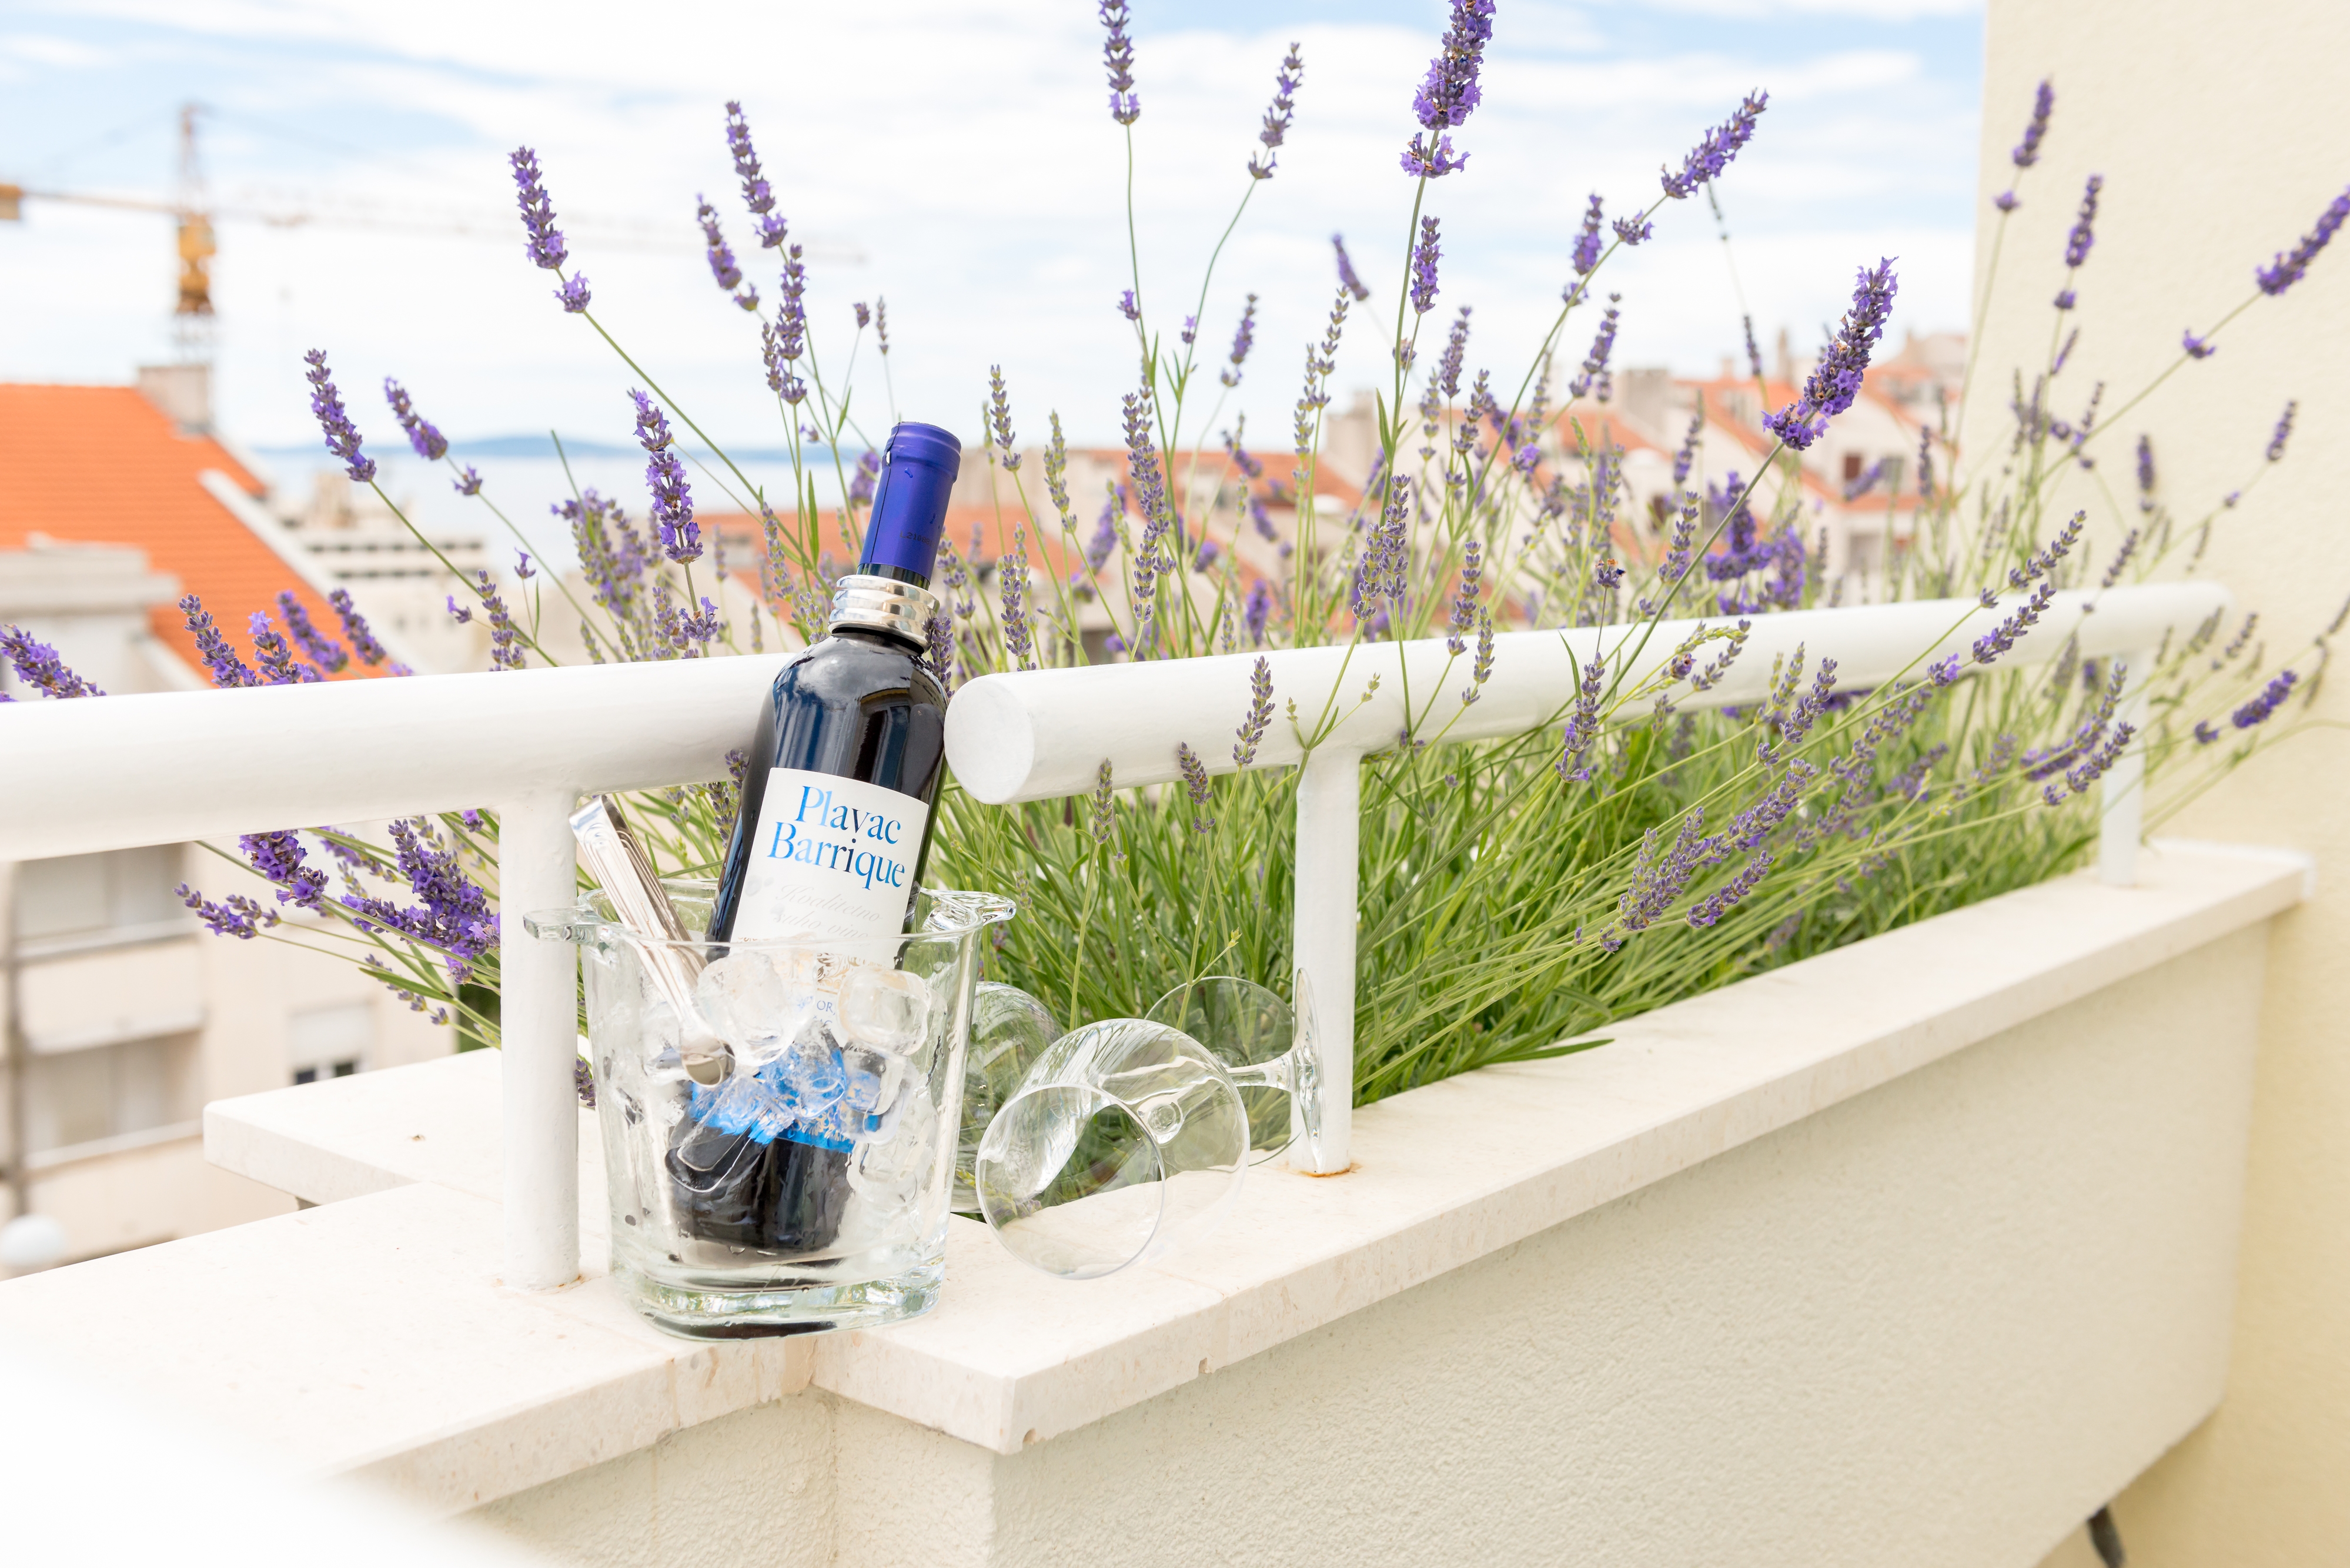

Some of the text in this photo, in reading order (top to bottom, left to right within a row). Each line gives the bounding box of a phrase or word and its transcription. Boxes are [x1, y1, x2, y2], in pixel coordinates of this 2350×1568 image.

[795, 785, 901, 844] Plavac
[767, 821, 905, 891] Barrique
[773, 911, 824, 930] suho
[775, 884, 882, 922] Kvalitetno
